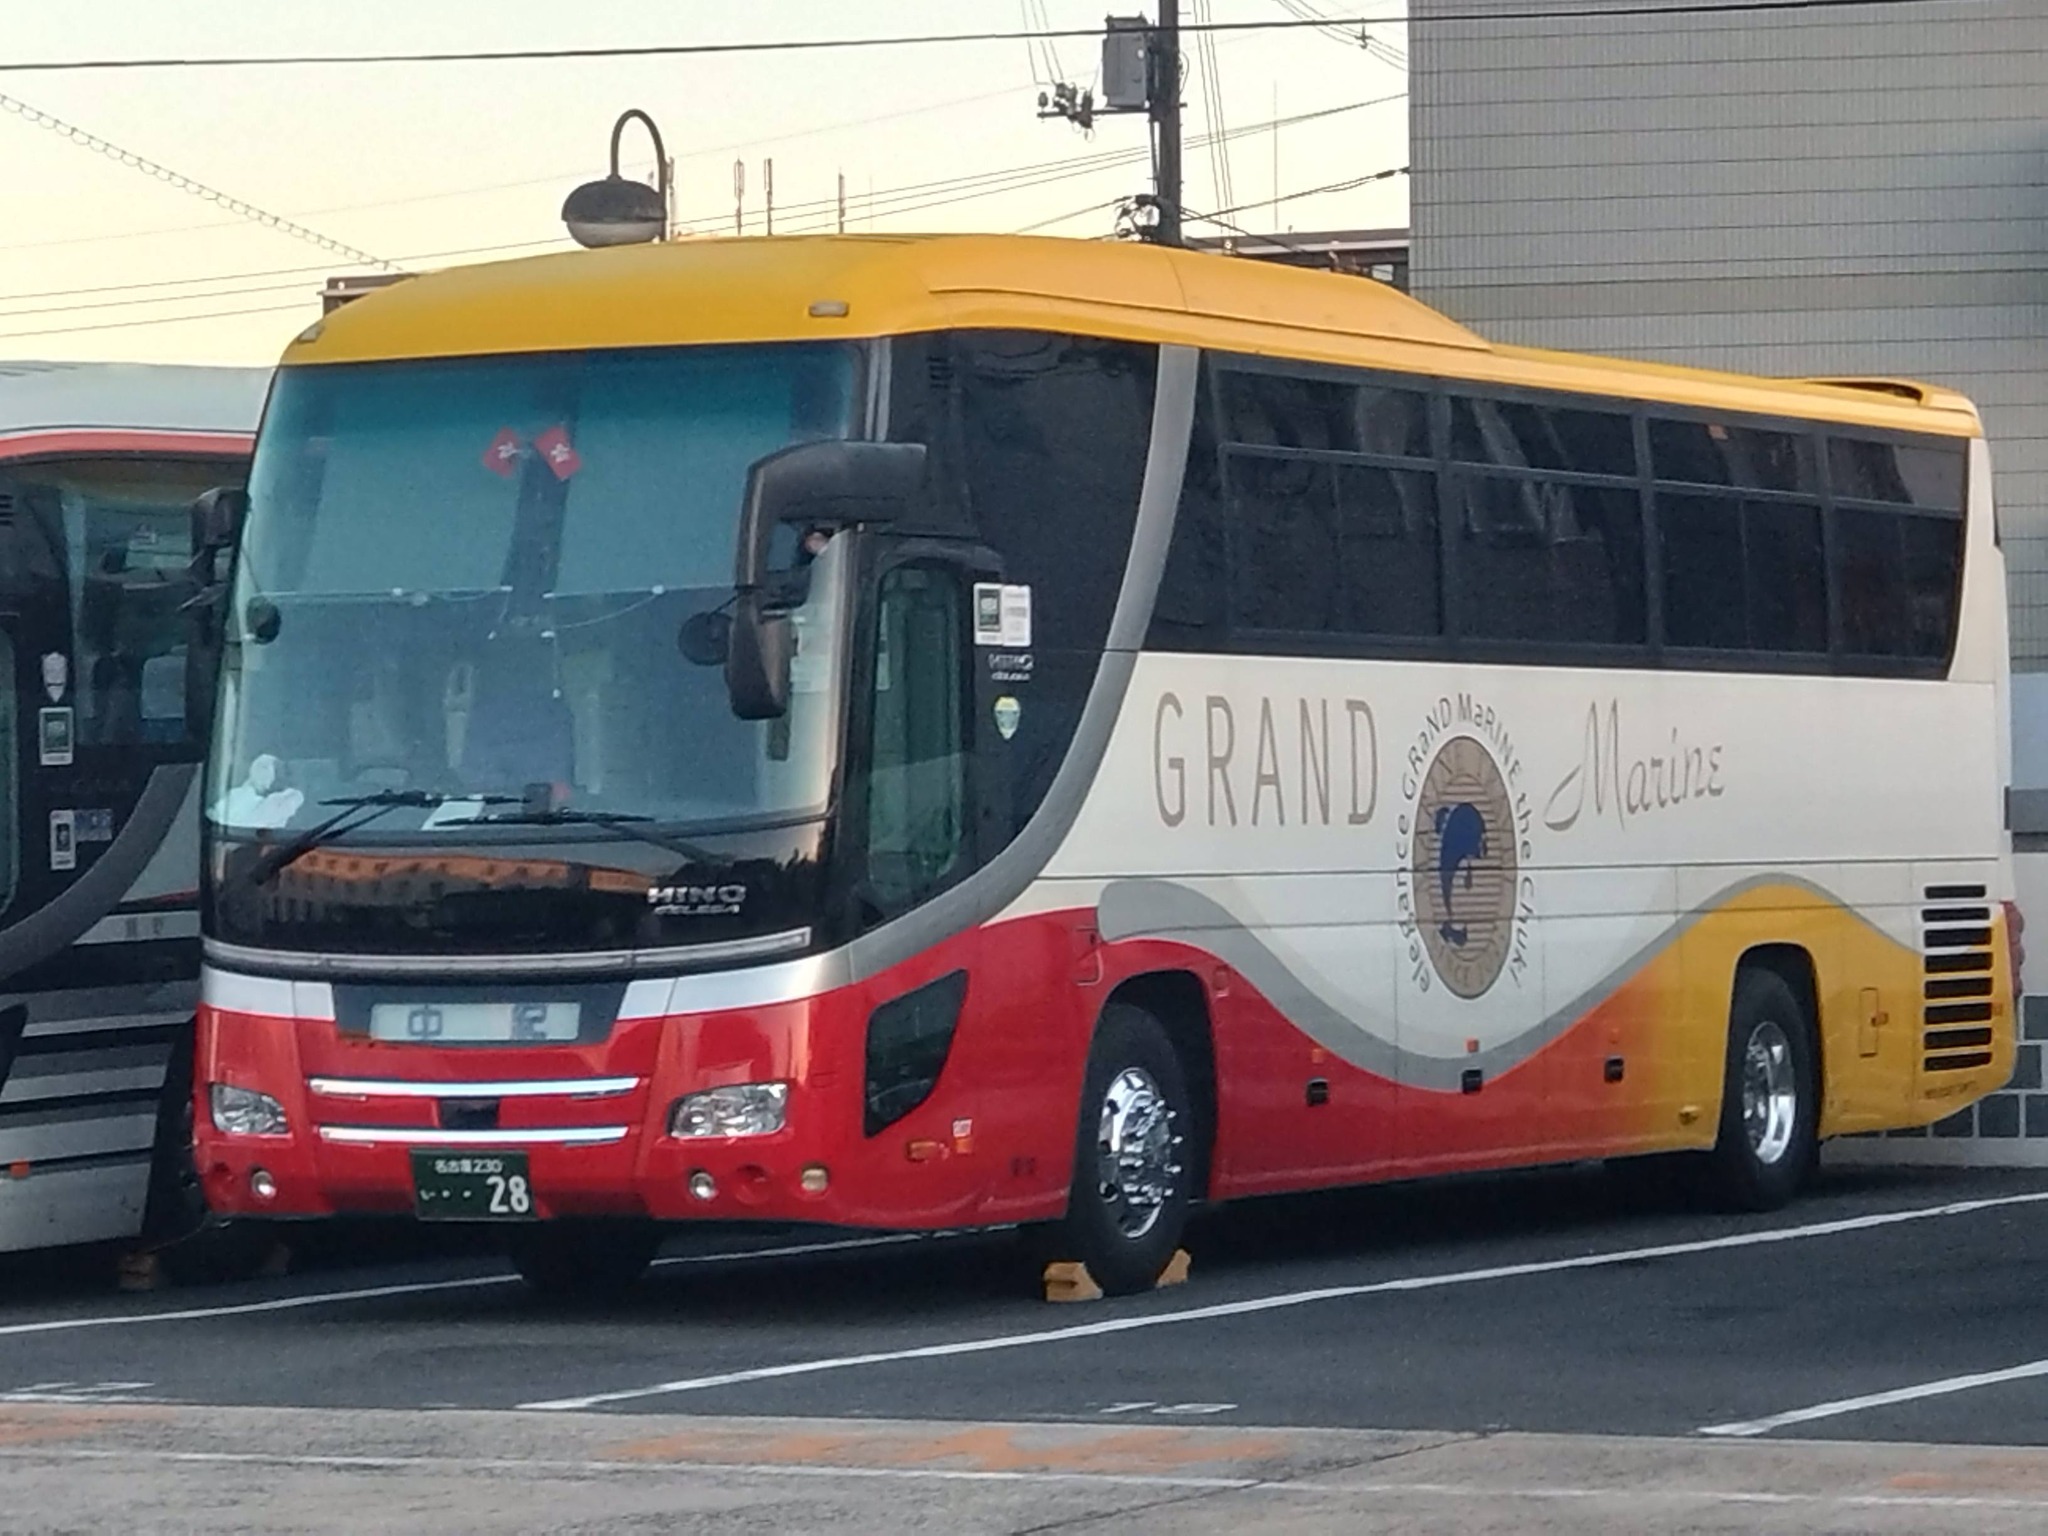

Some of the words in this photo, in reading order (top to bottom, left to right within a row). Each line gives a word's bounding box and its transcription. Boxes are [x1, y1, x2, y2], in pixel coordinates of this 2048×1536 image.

[1153, 692, 1377, 828] GRAND
[1543, 697, 1725, 832] Marine
[647, 885, 747, 903] HINO
[486, 1175, 530, 1213] 28
